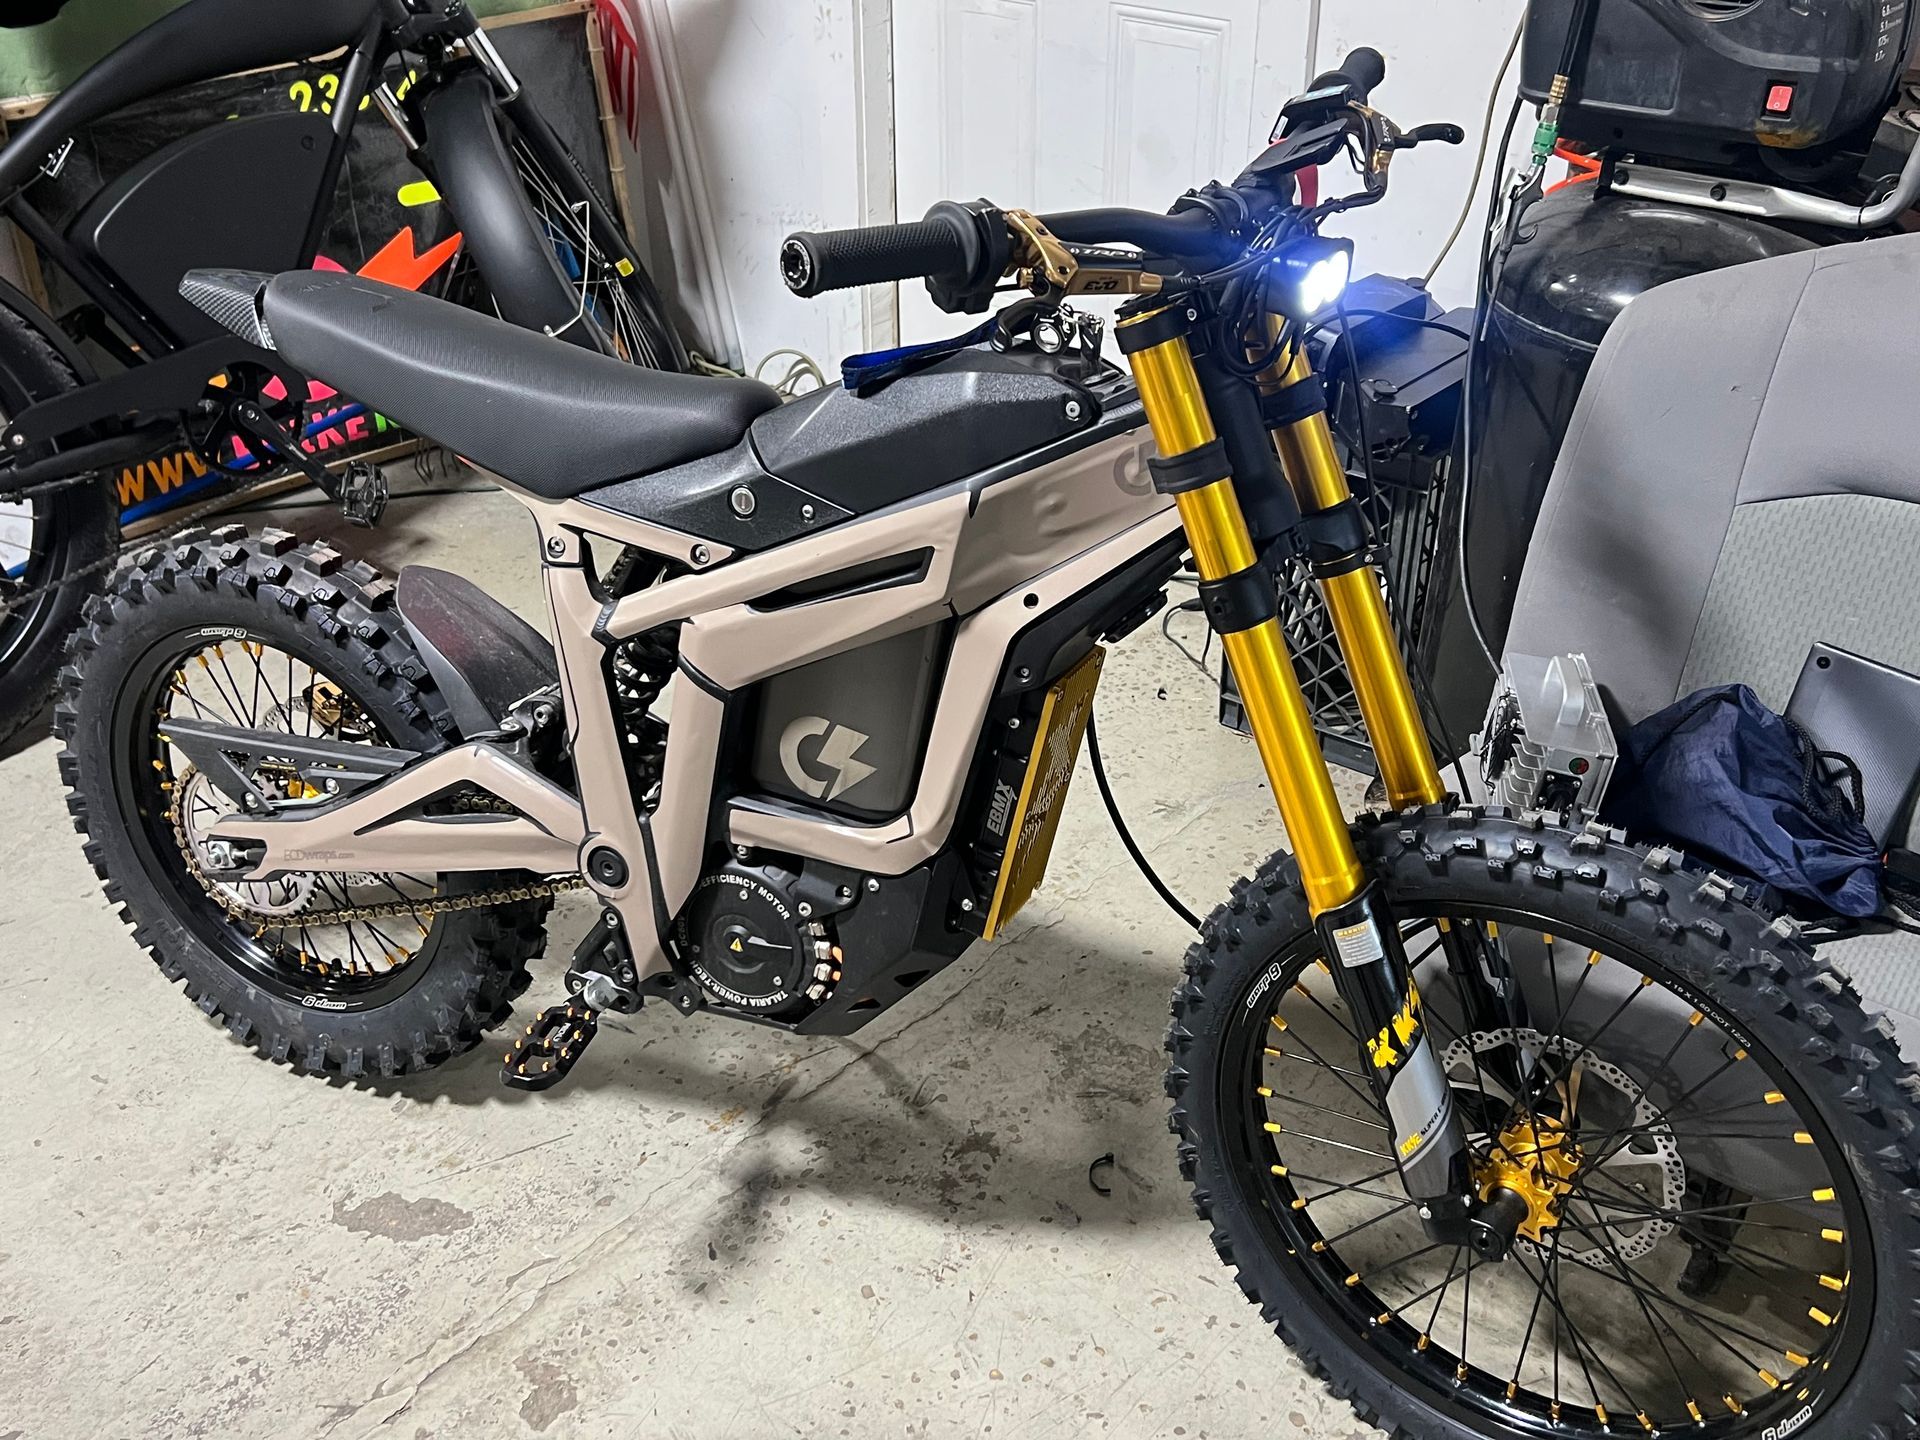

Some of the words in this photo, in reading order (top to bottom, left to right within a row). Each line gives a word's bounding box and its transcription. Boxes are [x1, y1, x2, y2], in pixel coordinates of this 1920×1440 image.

[987, 779, 1013, 835] EBMX
[700, 874, 757, 889] EFFICIENCY
[757, 886, 791, 920] MOTOR
[301, 995, 317, 1007] 9
[690, 960, 748, 1006] POWER-TECH
[749, 990, 788, 1007] TALARIA
[1246, 973, 1271, 1009] warp
[1269, 962, 1282, 981] 9
[314, 998, 347, 1010] warp
[1710, 1011, 1731, 1028] DOT
[1731, 1028, 1751, 1048] 12/23
[1776, 1405, 1813, 1440] warp
